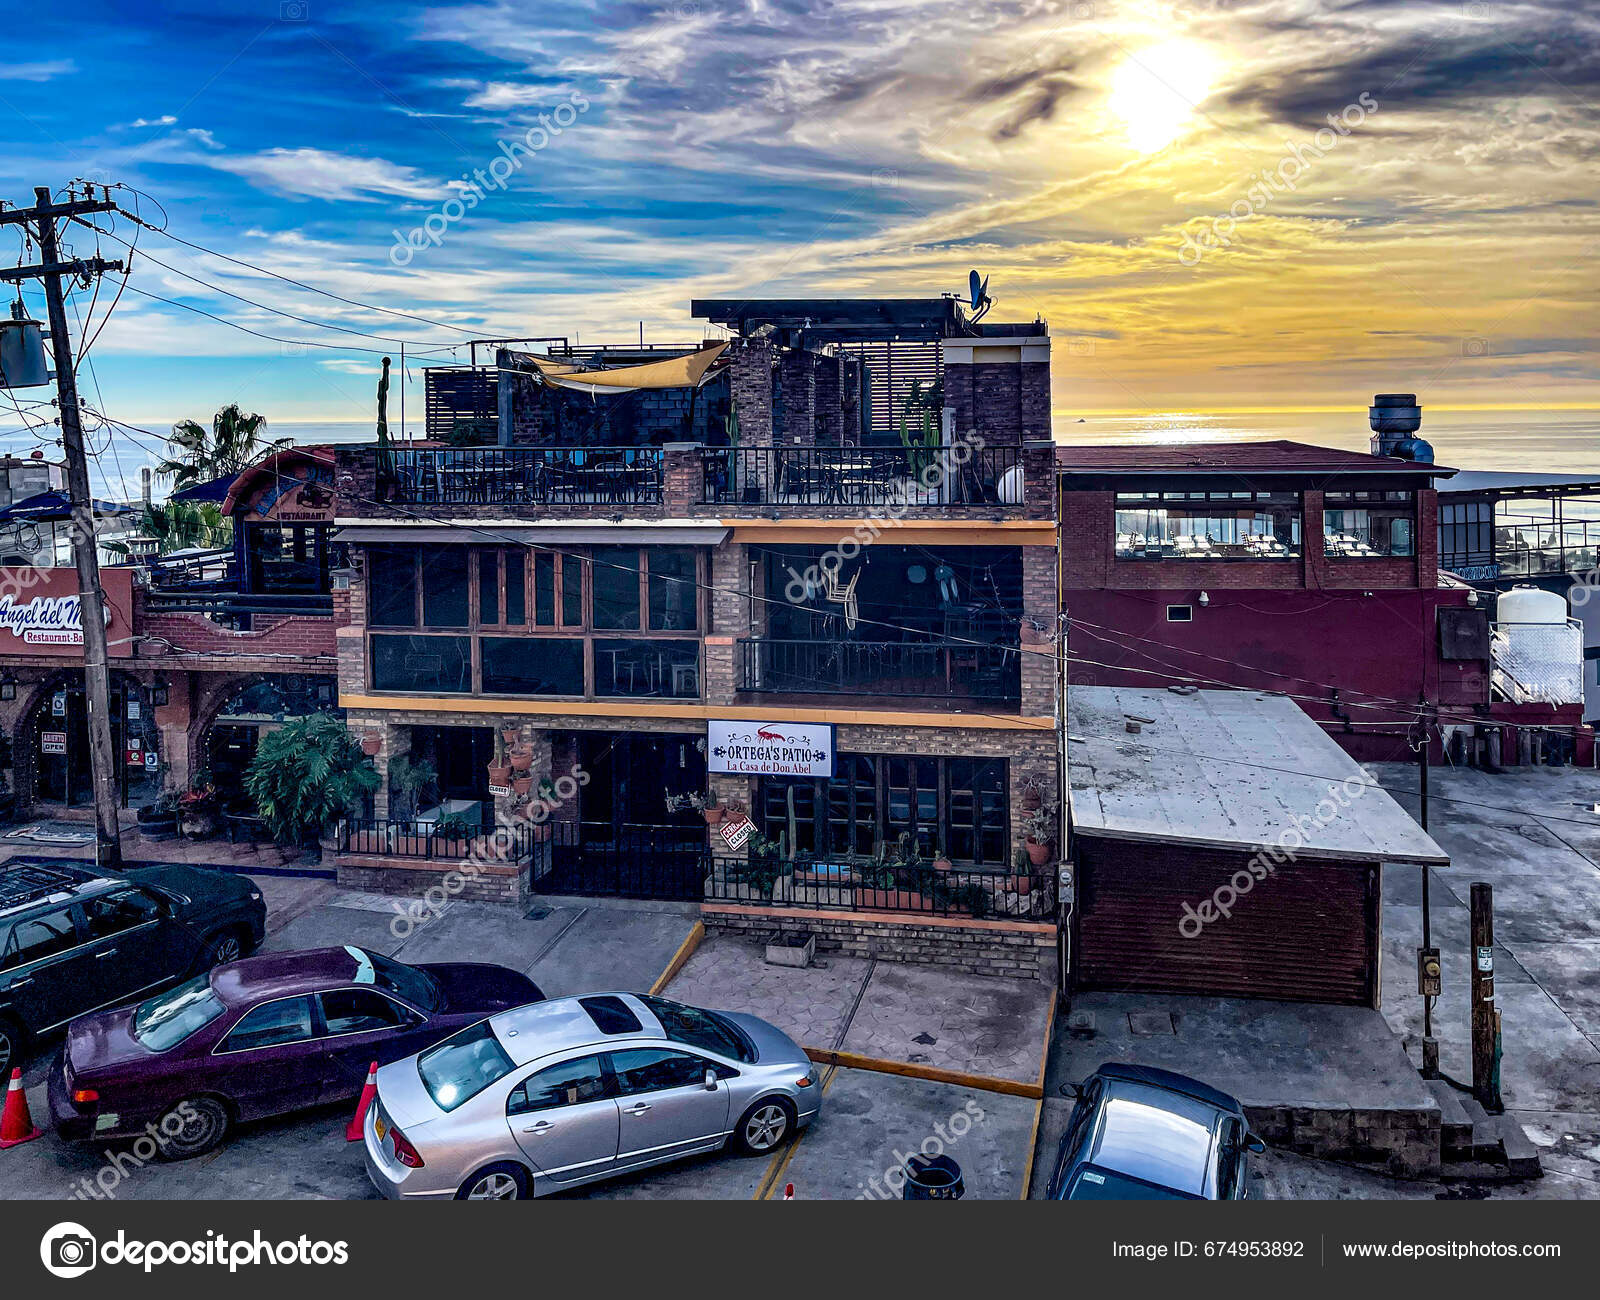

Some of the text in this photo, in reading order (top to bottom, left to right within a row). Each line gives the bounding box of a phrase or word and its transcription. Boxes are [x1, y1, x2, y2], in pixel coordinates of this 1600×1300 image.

[39, 600, 62, 624] del
[27, 633, 84, 642] Restaurant-Ba
[728, 746, 812, 762] ORTEGA'S PATIO
[727, 760, 811, 774] La Casa de Don Abel
[730, 824, 752, 844] CLOSED
